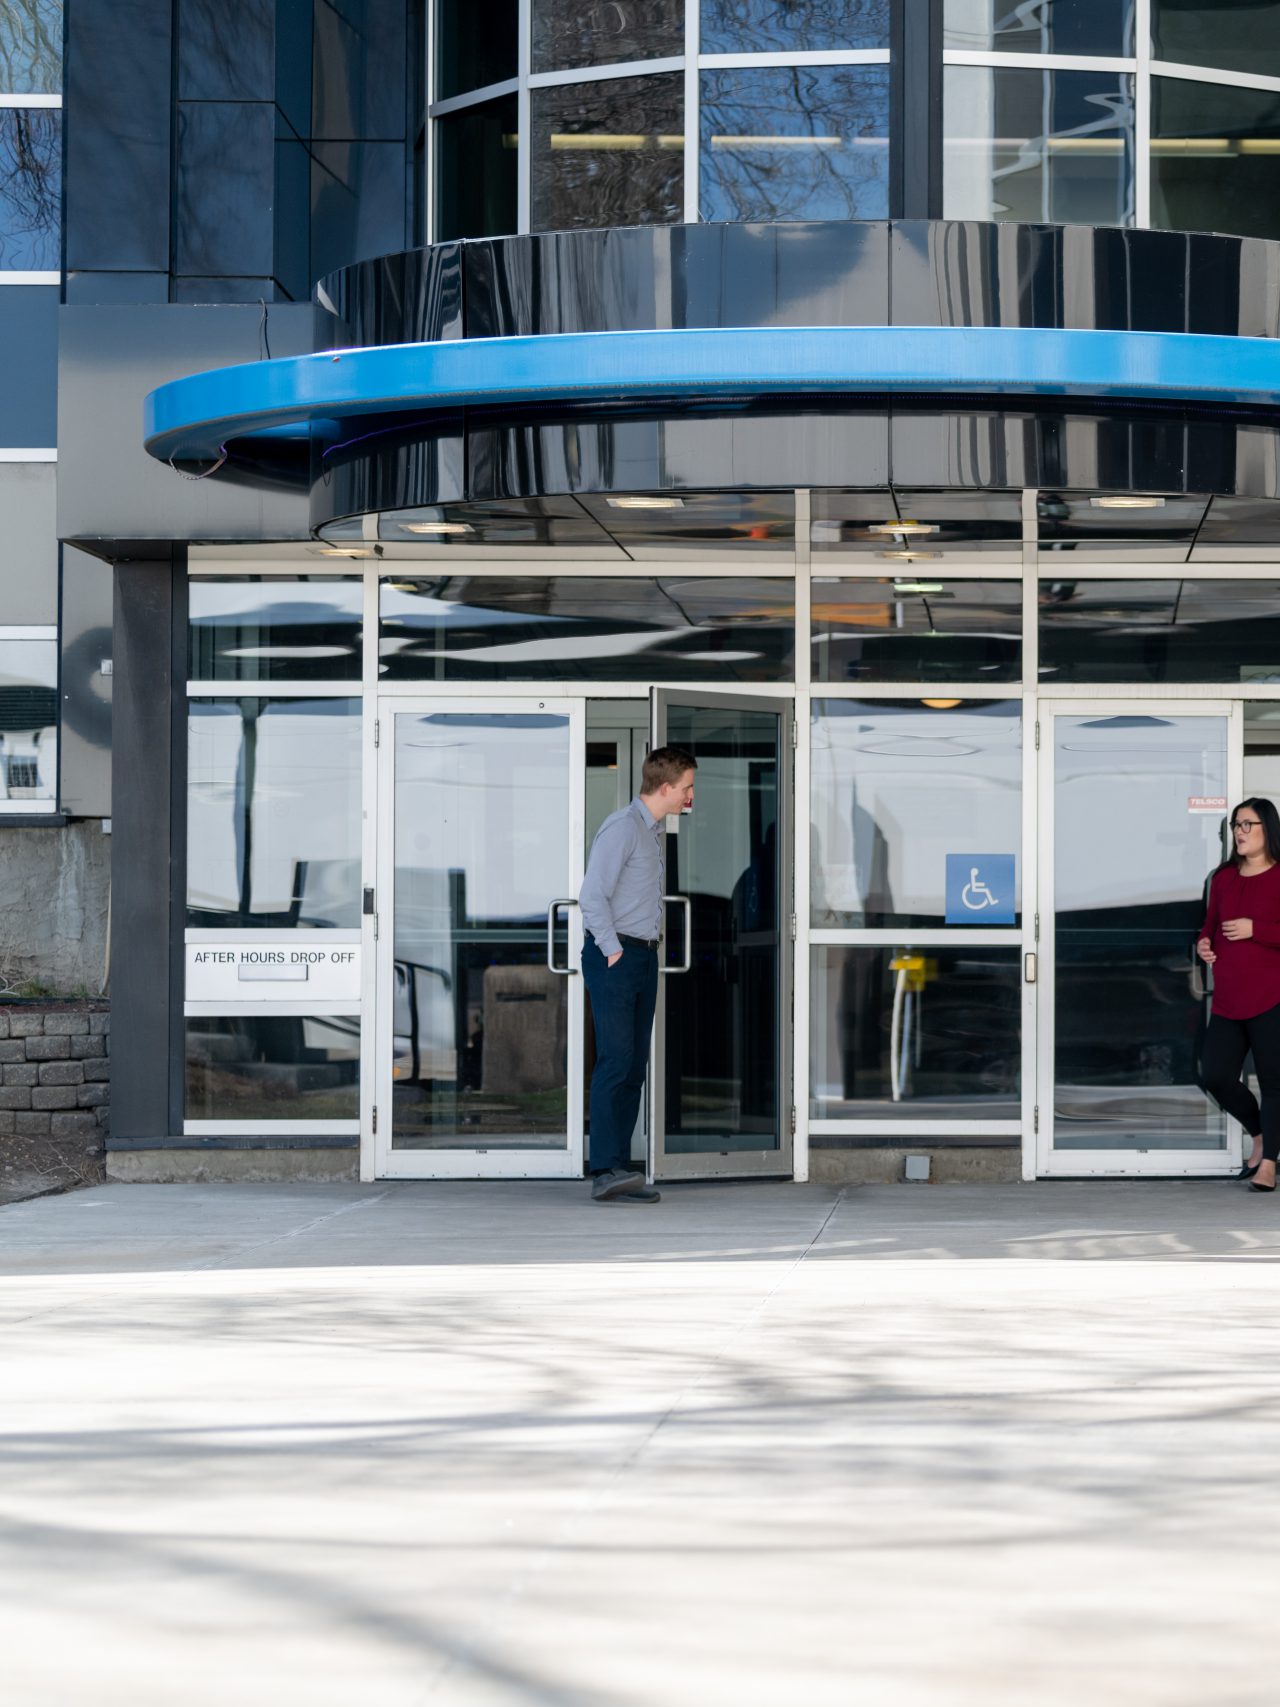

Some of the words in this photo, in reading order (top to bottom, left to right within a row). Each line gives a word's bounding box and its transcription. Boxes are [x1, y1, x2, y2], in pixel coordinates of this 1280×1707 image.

[195, 952, 235, 963] AFTER
[241, 952, 285, 963] HOURS
[291, 952, 325, 963] DROP
[331, 952, 355, 963] OFF
